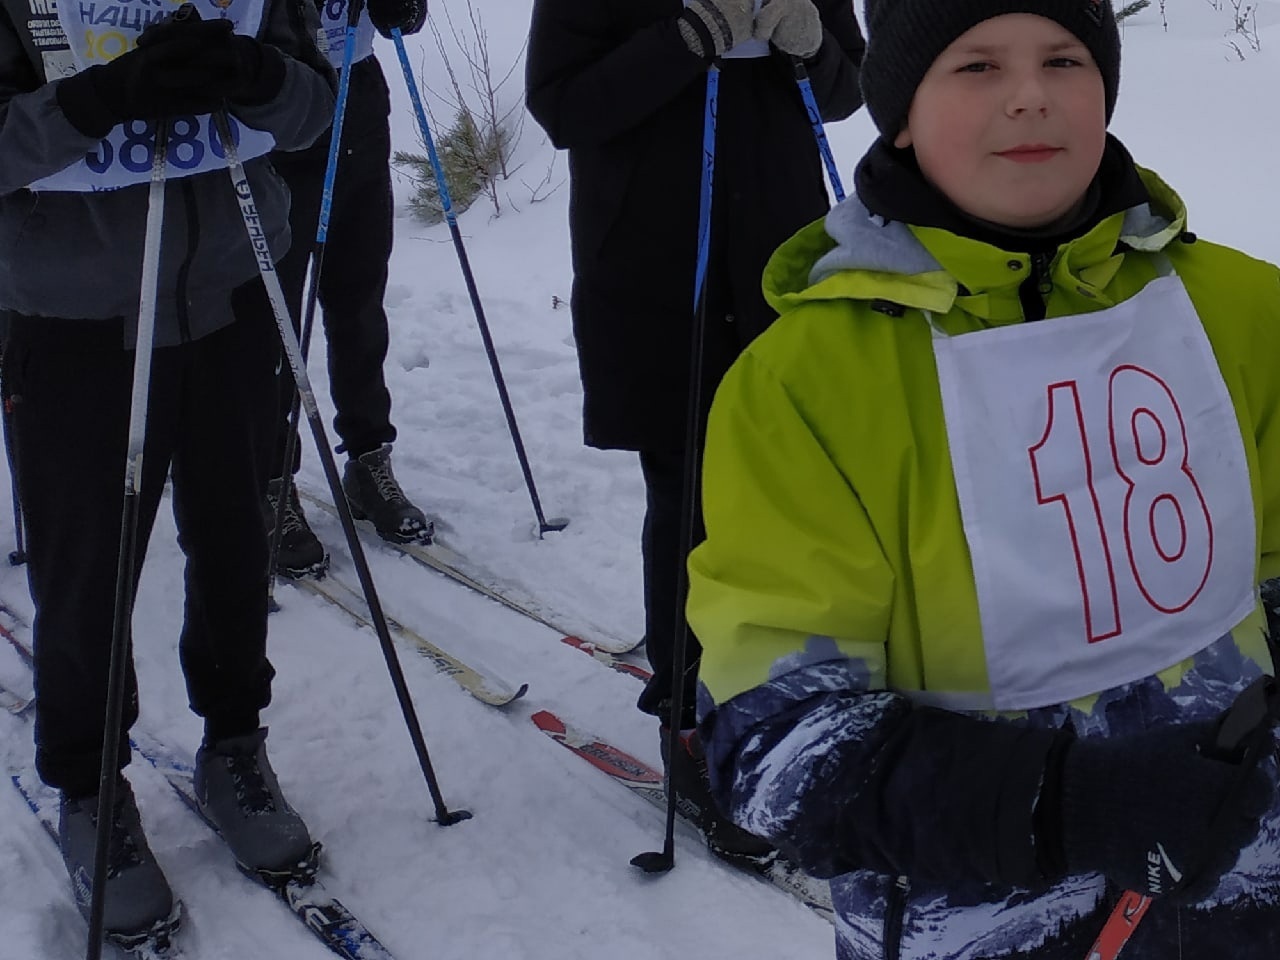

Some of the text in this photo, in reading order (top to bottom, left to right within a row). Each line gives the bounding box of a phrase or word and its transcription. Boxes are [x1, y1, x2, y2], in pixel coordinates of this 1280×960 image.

[78, 1, 177, 32] НАЦИ
[1027, 363, 1214, 644] 18
[1147, 850, 1162, 894] NIKE
